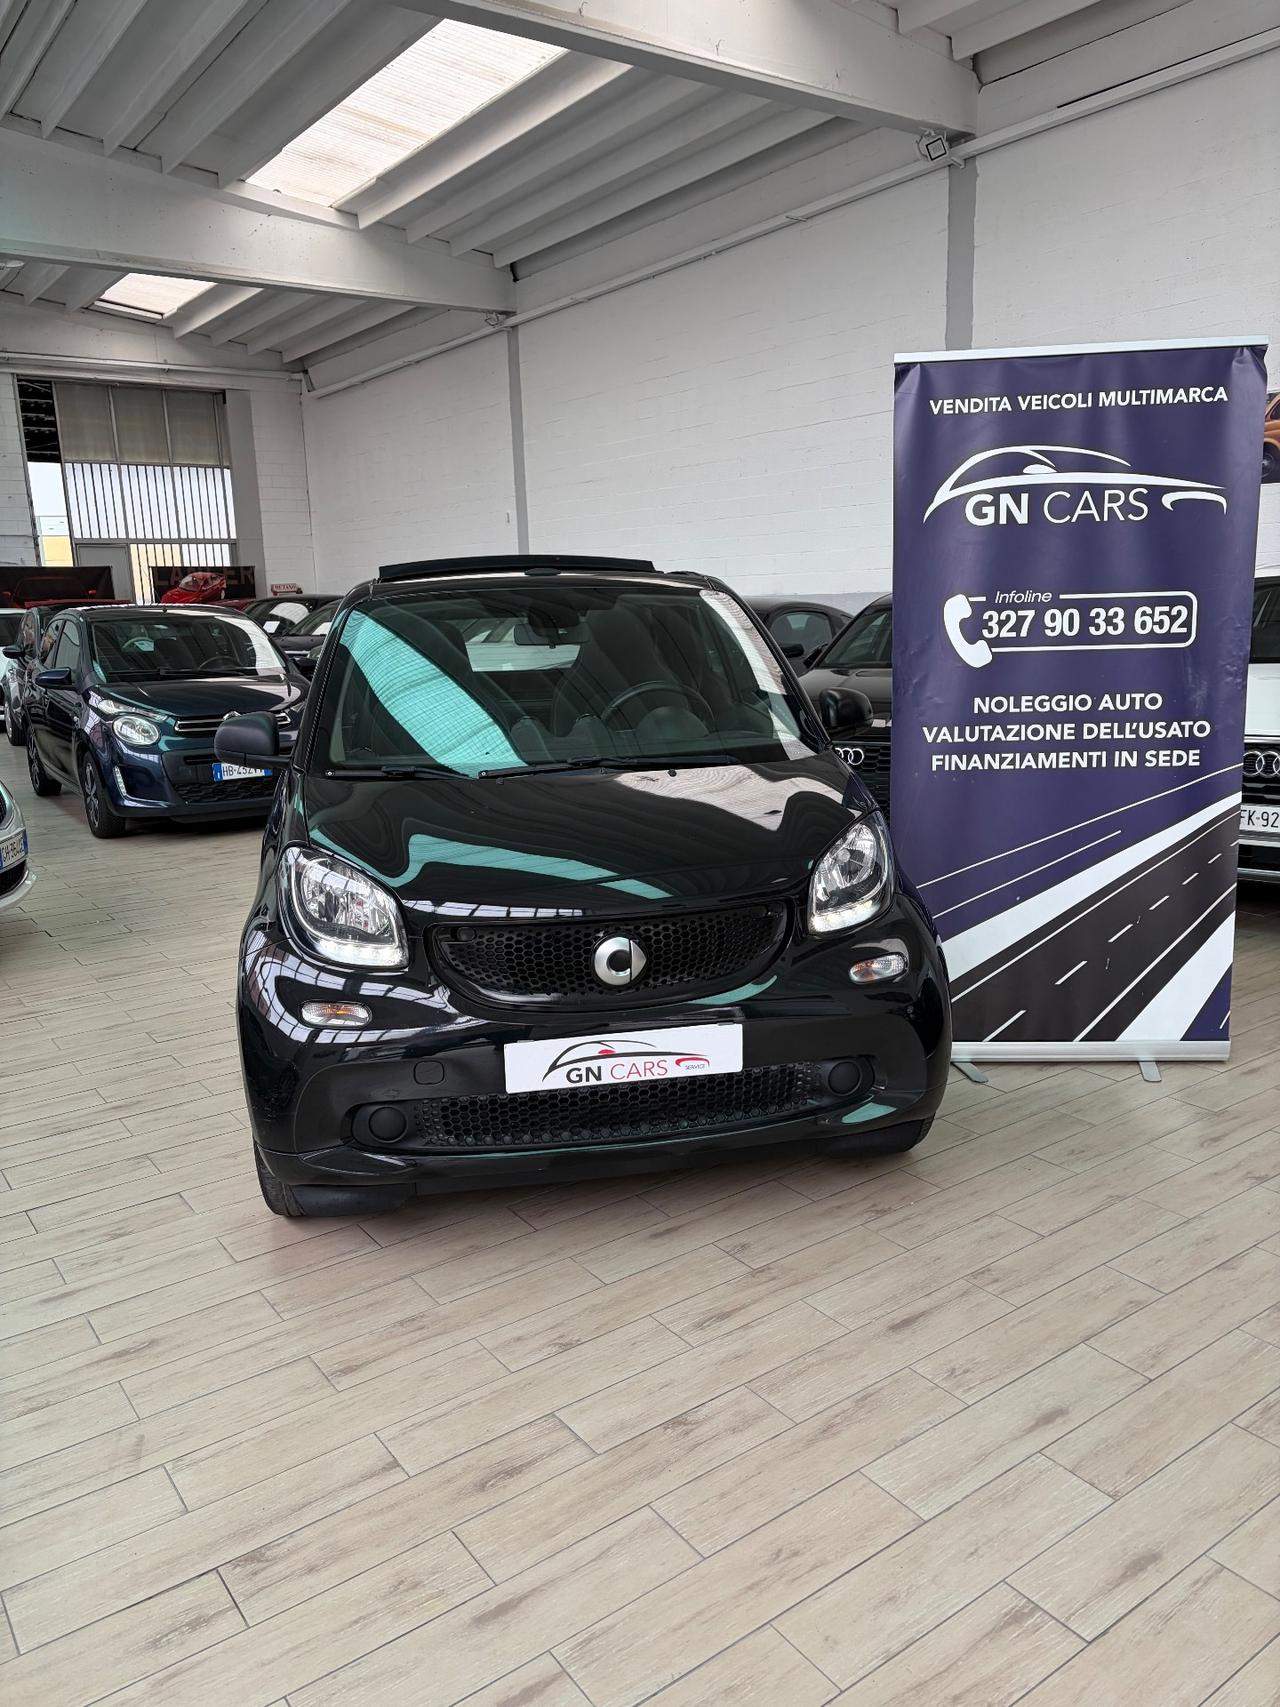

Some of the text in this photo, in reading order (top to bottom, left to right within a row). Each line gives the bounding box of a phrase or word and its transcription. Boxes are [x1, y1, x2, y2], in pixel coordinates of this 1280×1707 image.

[930, 387, 1228, 415] VENDITA VEICOLI MULTIMARCA
[965, 488, 1149, 526] GN CARS
[995, 590, 1052, 604] Infoline
[982, 605, 1188, 639] 327 90 33 652
[973, 694, 1163, 714] NOLEGGIO AUTO
[923, 720, 1211, 744] VALUTAZIONE DELL'USATO
[931, 749, 1201, 772] FINANZIAMENTI IN SEDE
[566, 1060, 668, 1083] GN CARS
